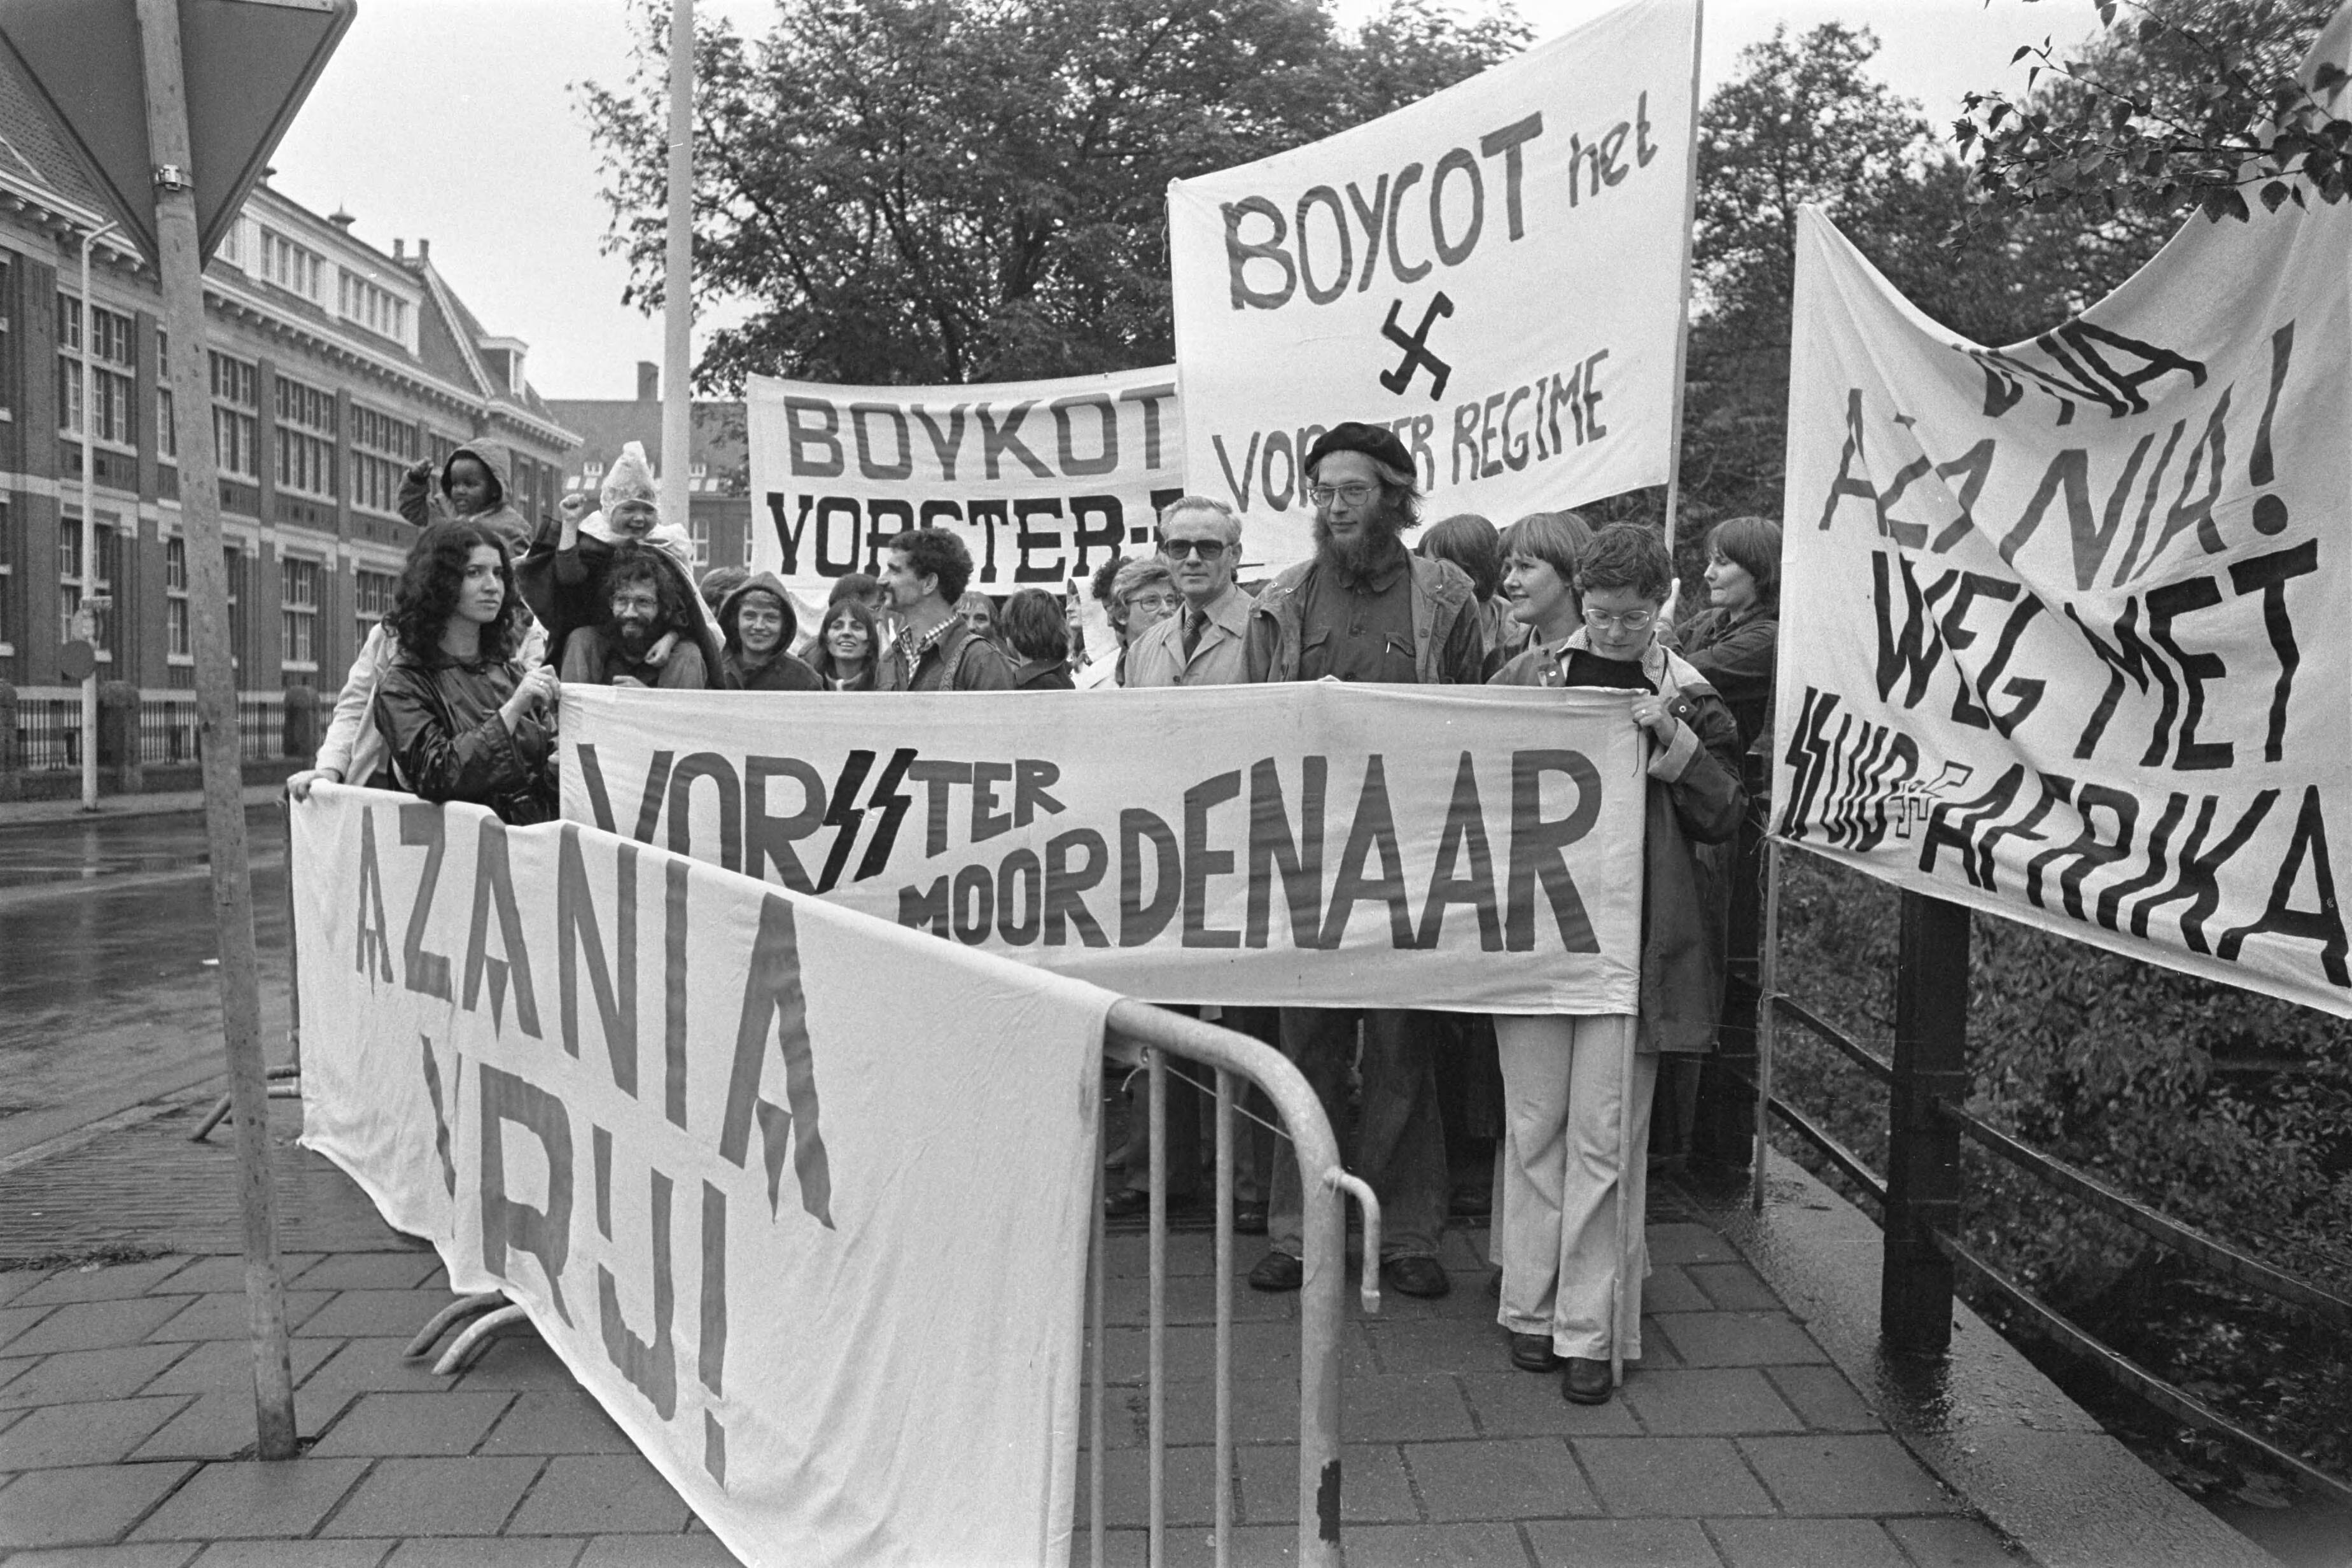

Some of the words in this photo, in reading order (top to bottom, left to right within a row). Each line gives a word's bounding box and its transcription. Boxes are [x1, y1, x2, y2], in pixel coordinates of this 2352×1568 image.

[1220, 110, 1544, 311] BOYCOT
[1569, 90, 1658, 208] het
[783, 382, 1176, 480] BOYKOT
[1452, 348, 1609, 485] REGIME
[1872, 550, 2048, 739] WEG
[2064, 537, 2318, 771] MET
[897, 750, 1602, 954] MOORDENAAR
[1918, 762, 2351, 988] AFRIKA
[356, 802, 837, 1232] AZANIA
